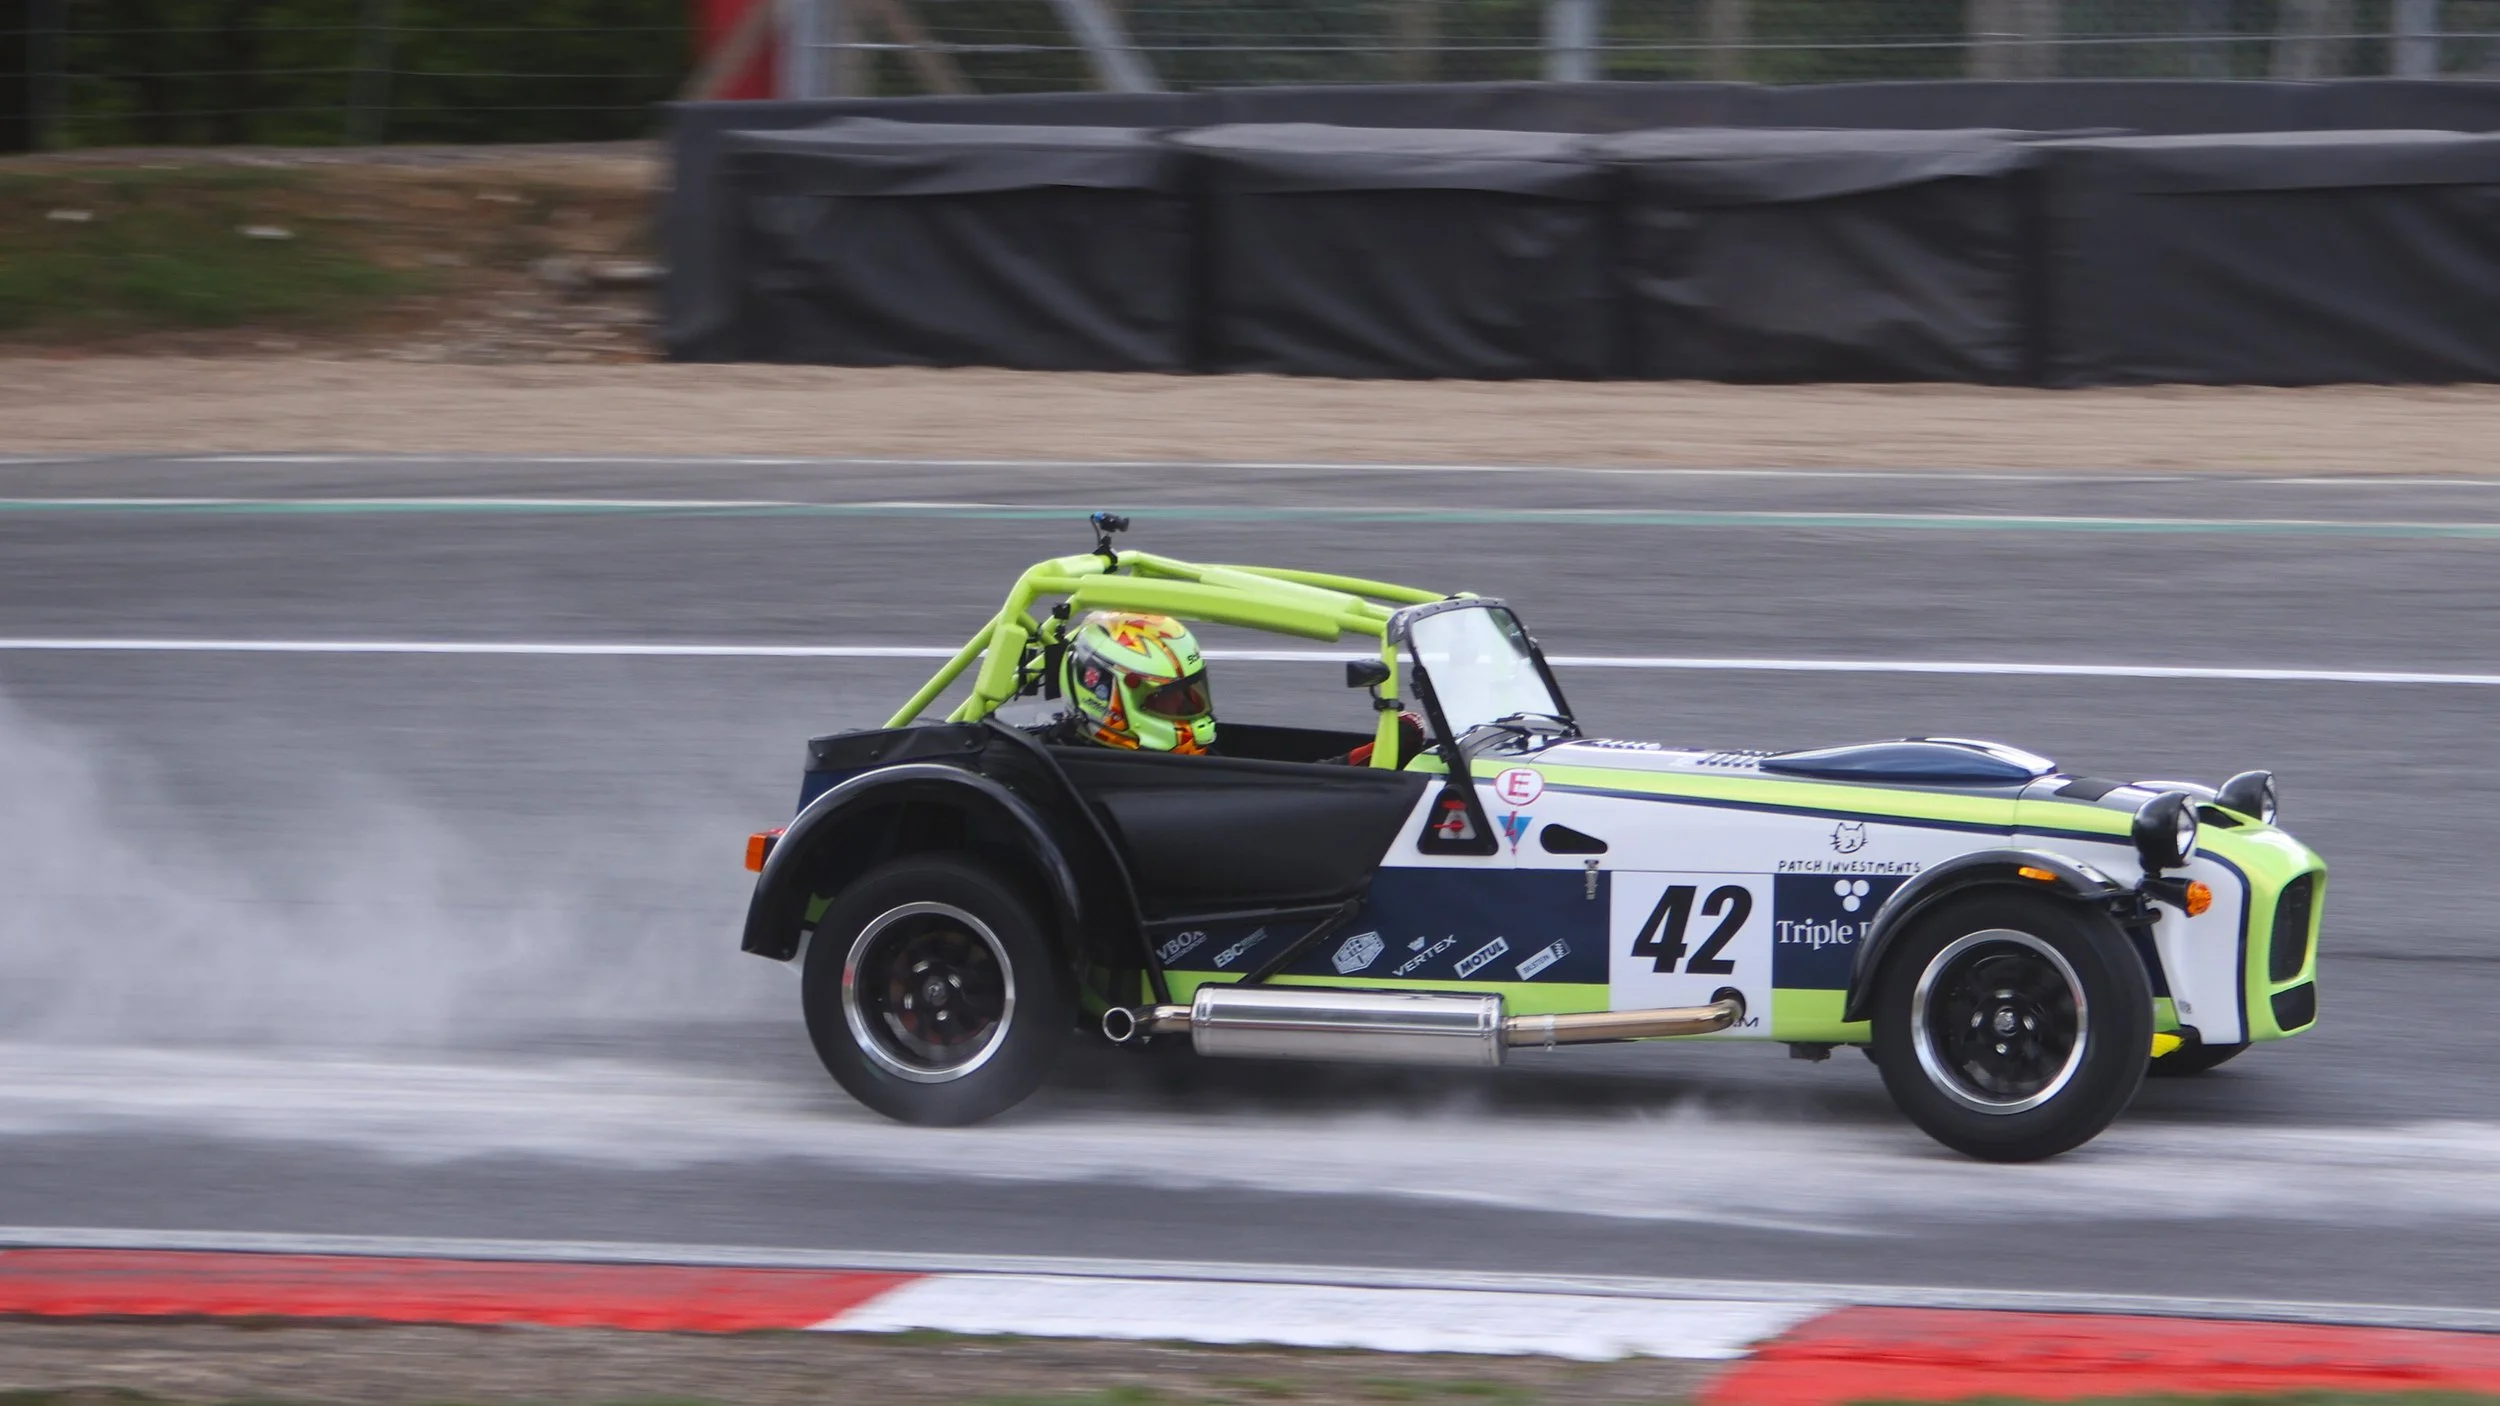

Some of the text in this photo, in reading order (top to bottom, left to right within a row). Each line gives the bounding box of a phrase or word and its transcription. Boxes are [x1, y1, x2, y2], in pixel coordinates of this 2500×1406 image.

[1508, 772, 1531, 798] E
[1778, 860, 1922, 874] PATCH INVESTMENTS
[1631, 885, 1753, 975] 42
[1775, 918, 1854, 950] Triple
[1213, 942, 1245, 969] EBC
[1391, 934, 1458, 977] VERTEX
[1459, 940, 1506, 974] MOTUL
